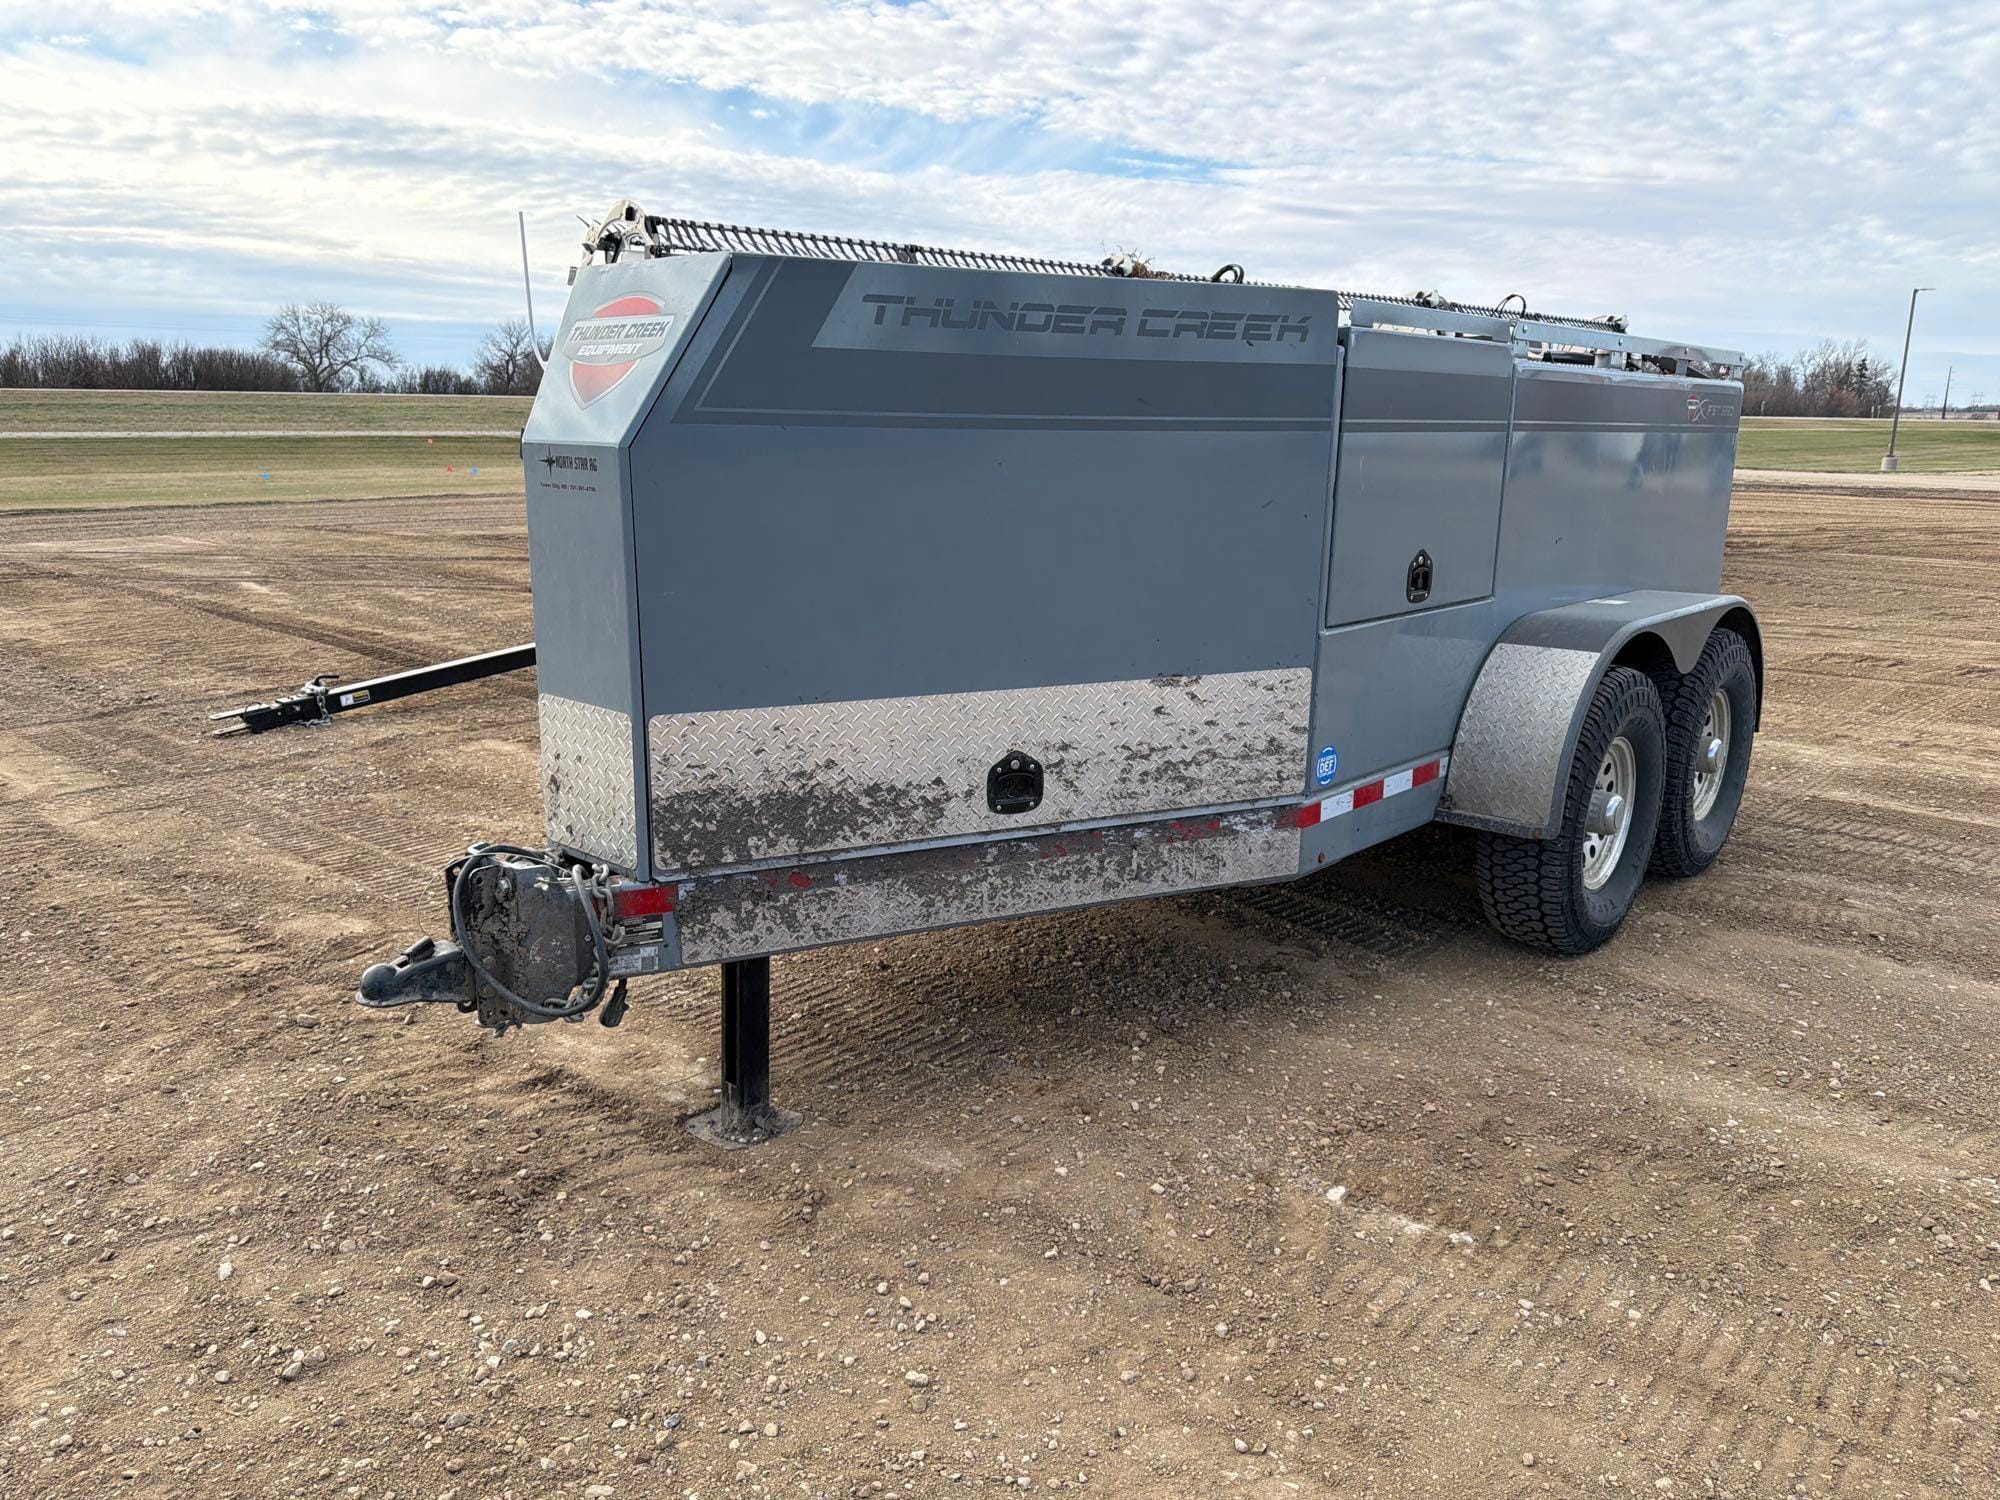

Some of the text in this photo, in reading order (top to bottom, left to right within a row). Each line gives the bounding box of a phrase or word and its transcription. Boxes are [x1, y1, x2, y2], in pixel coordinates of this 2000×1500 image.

[862, 294, 1312, 342] THUNDER CREEK
[569, 321, 670, 341] THUNDER CREEK
[576, 343, 644, 356] EQUIPMENT
[556, 455, 598, 472] NORTH STAR AG
[1319, 759, 1334, 774] DEF
